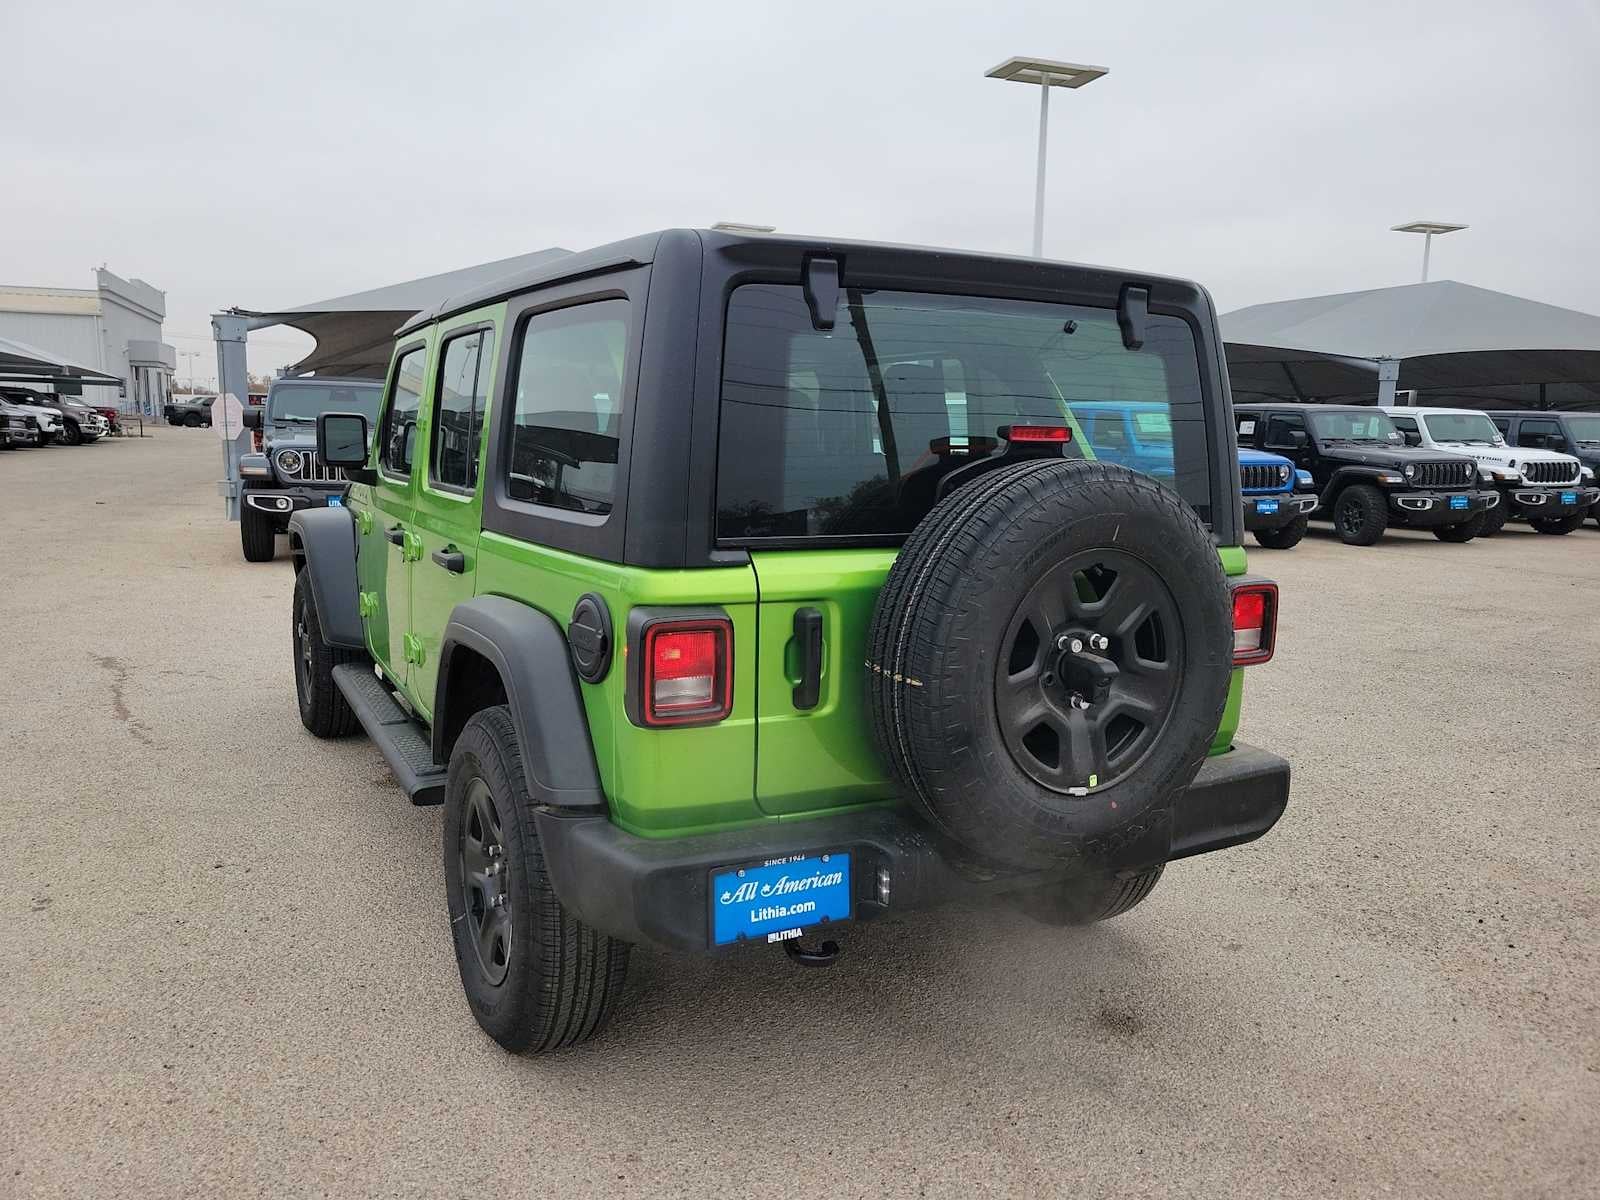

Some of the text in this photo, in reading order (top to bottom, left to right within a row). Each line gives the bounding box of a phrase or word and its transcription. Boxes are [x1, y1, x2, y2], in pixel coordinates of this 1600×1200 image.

[764, 857, 787, 867] SINCE
[720, 872, 843, 904] All American
[751, 900, 816, 922] Lithia.com
[776, 927, 803, 941] LITHIA
